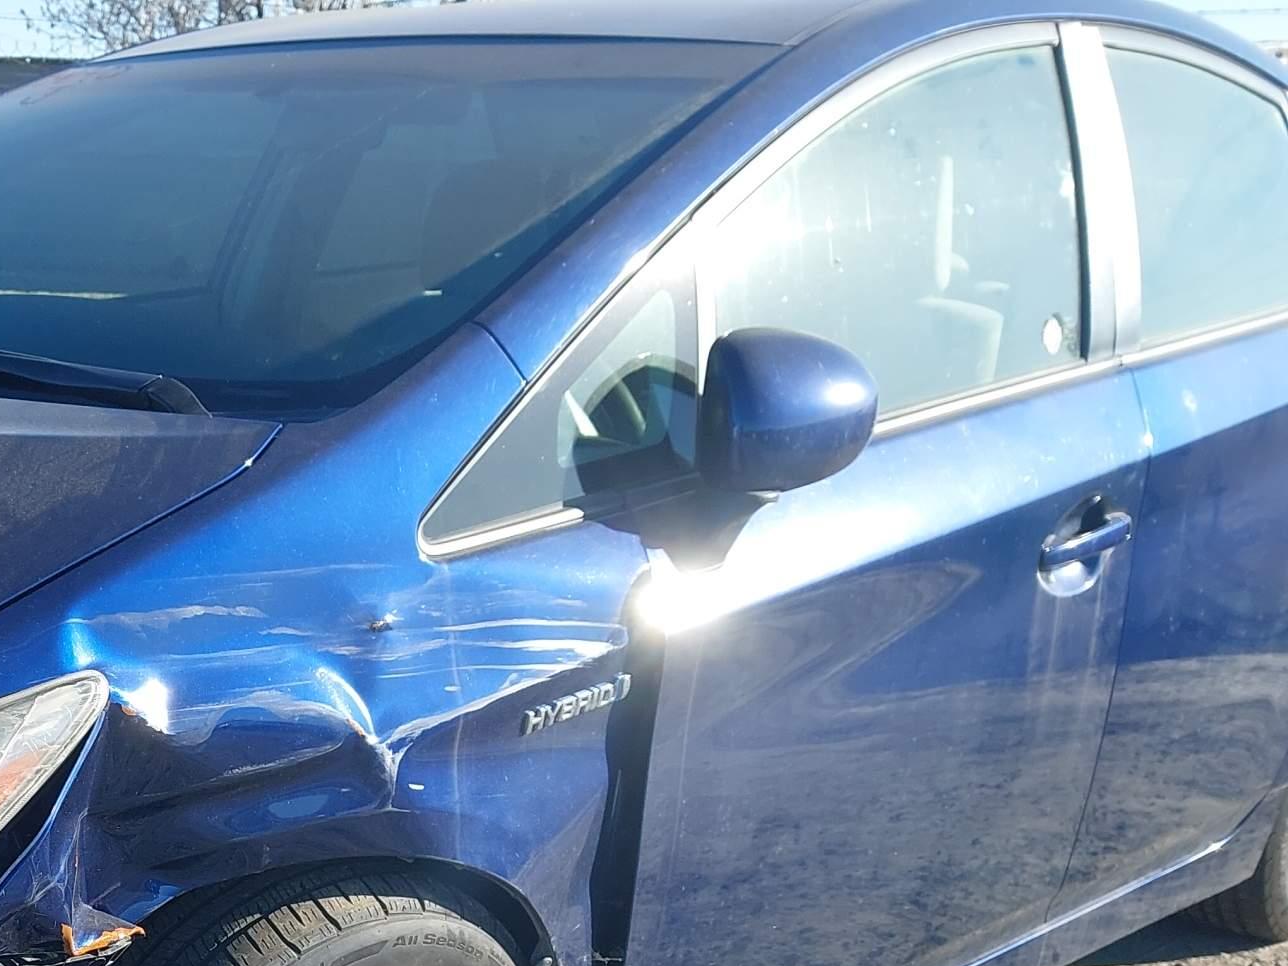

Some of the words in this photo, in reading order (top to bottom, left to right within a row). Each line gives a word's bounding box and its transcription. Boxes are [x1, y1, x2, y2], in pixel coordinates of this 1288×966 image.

[520, 682, 616, 737] HYBRID
[392, 935, 419, 949] All
[422, 932, 484, 962] Season
